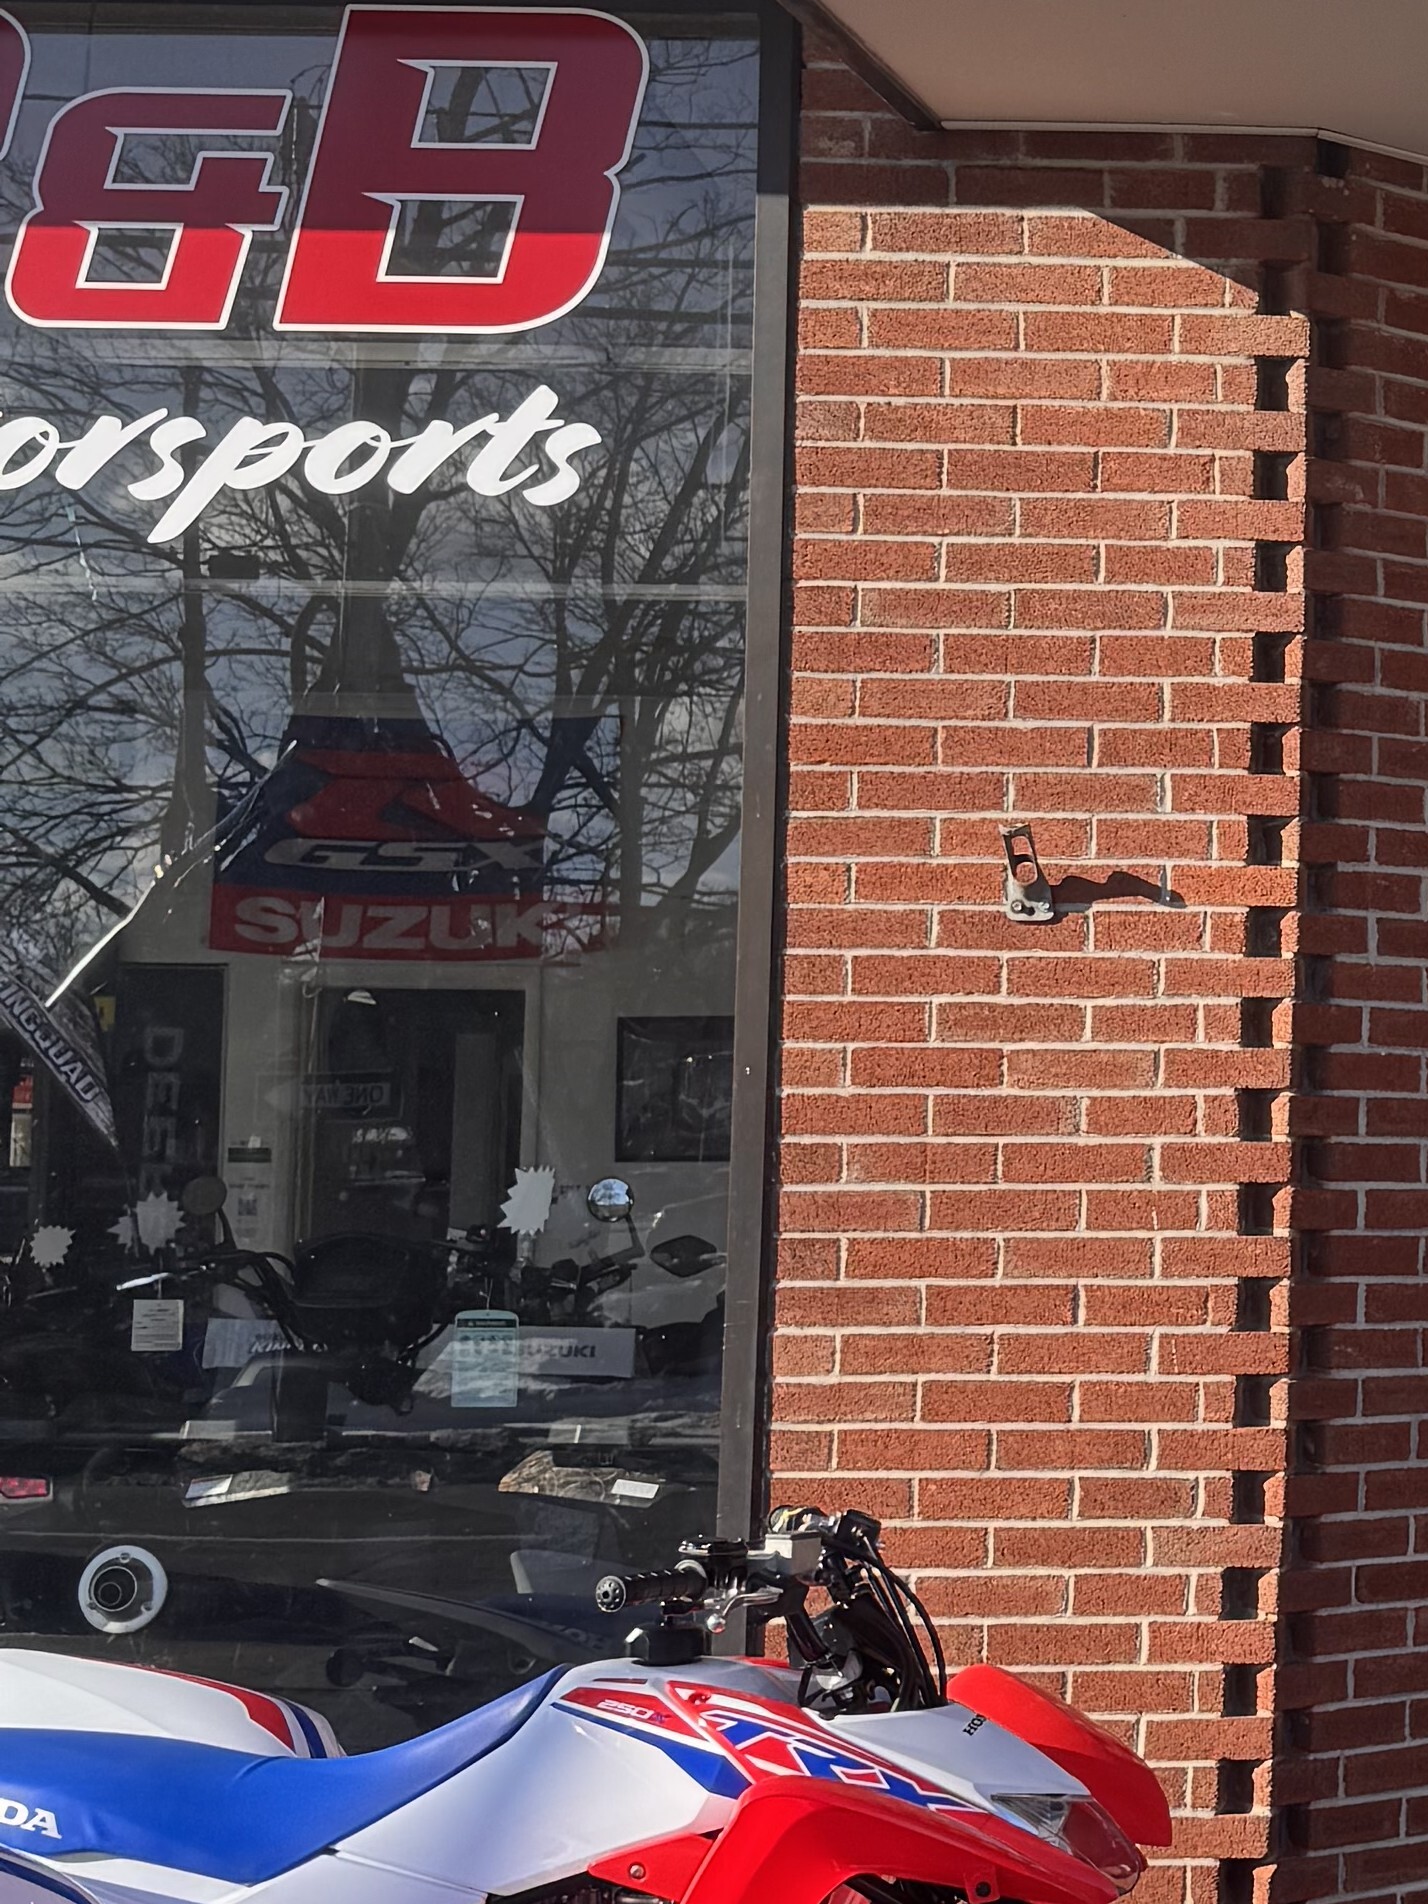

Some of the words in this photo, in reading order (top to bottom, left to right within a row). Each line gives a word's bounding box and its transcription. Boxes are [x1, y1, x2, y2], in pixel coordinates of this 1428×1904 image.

[0, 3, 651, 335] &B
[0, 384, 602, 544] orsports
[264, 837, 550, 872] GSX
[234, 895, 583, 952] SUZUK
[0, 975, 101, 1102] INGQUAD
[961, 1712, 988, 1738] HO
